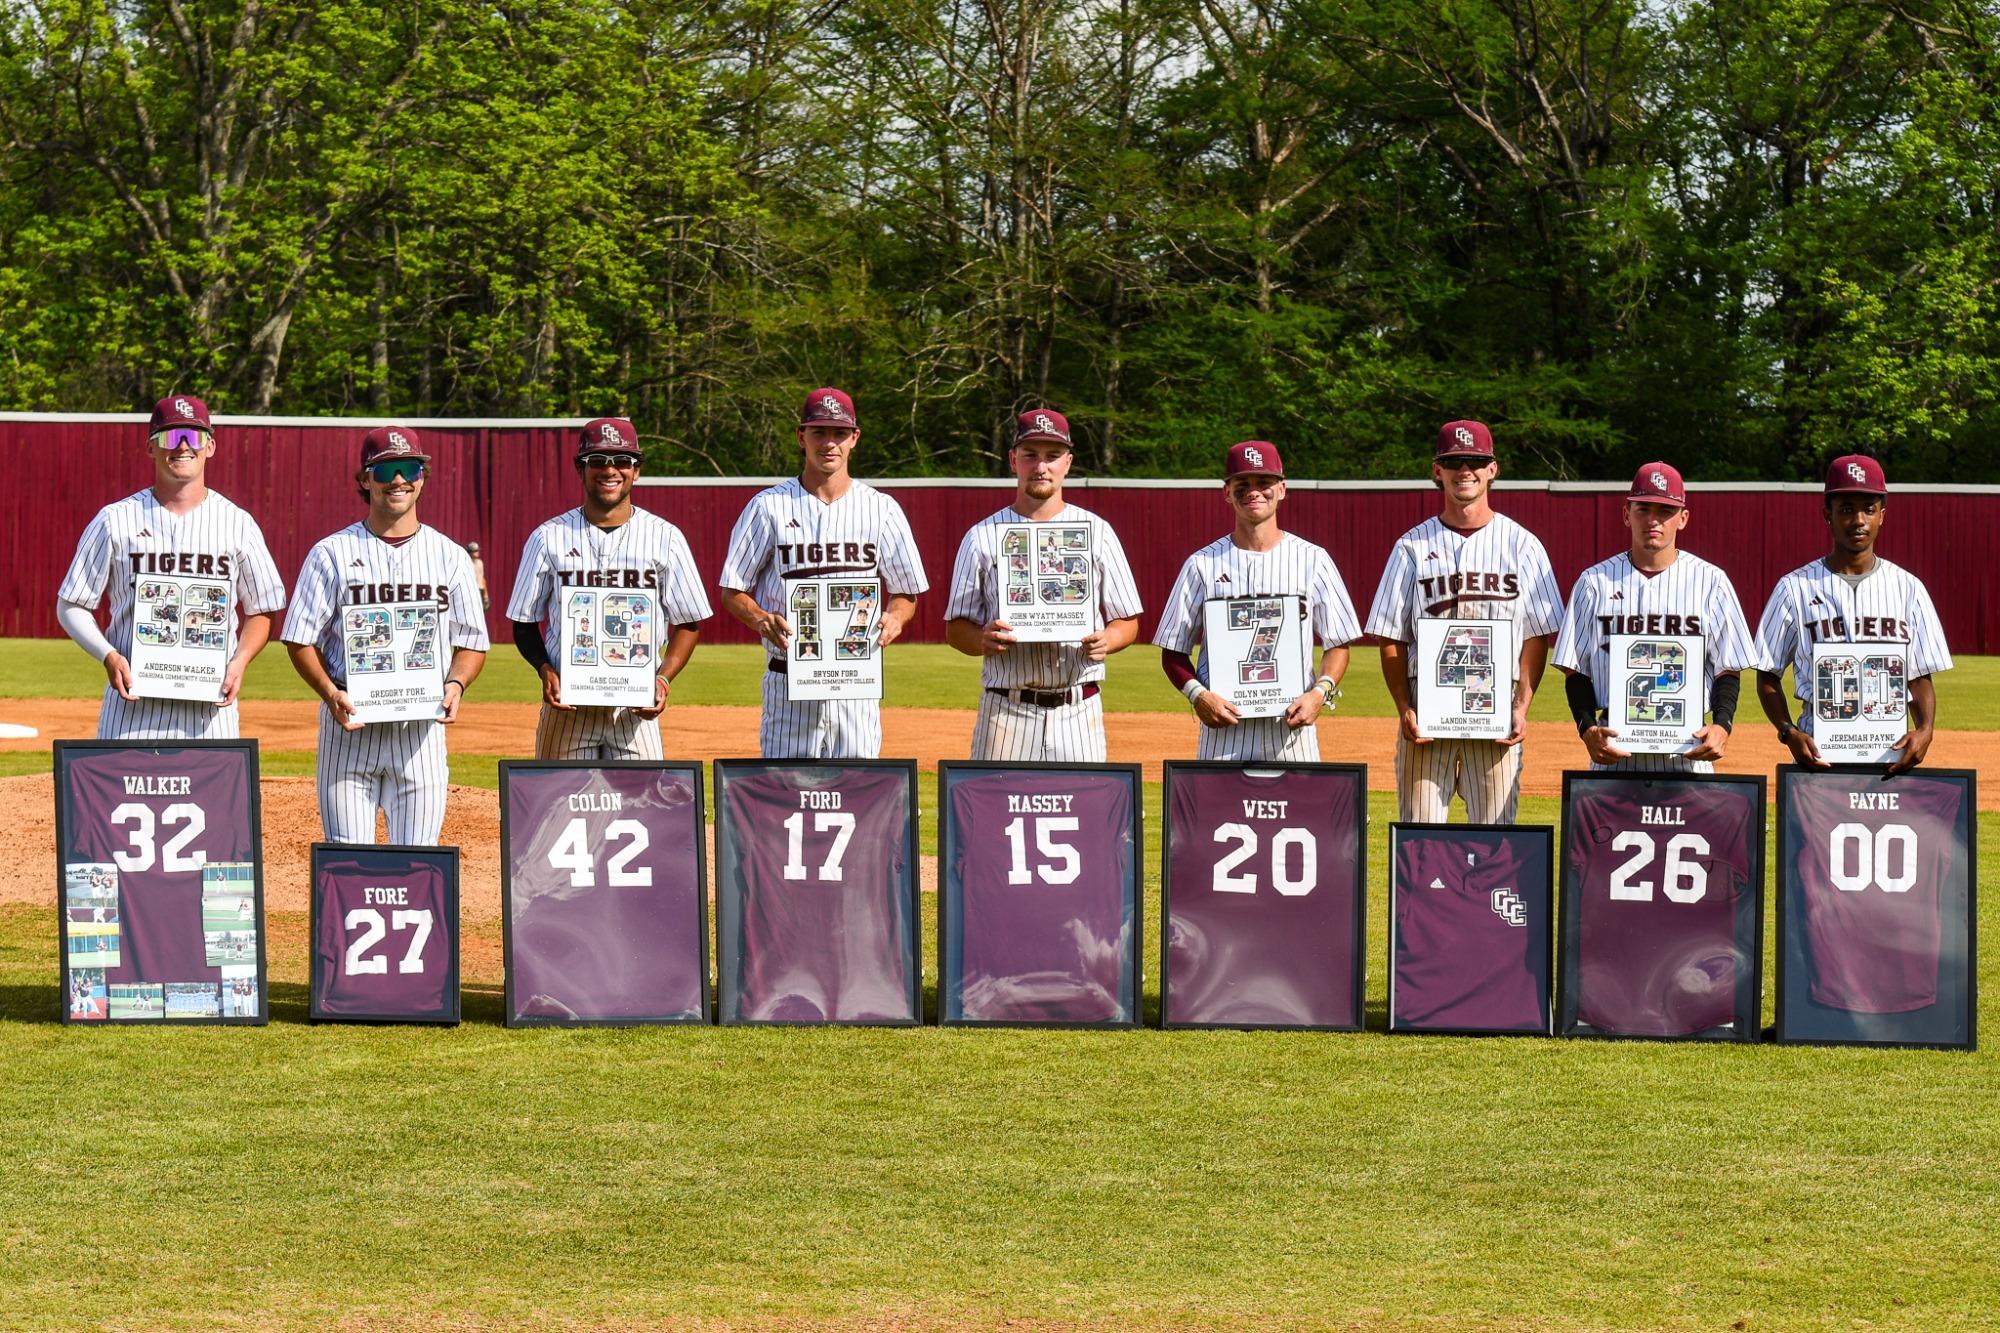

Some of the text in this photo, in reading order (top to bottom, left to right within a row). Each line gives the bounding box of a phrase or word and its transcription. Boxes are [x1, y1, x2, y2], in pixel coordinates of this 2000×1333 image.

[128, 552, 231, 577] TIGERS
[777, 542, 877, 564] TIGERS
[558, 569, 656, 588] TIGERS
[1001, 527, 1090, 605] 15
[349, 583, 450, 606] TIGERS
[1418, 572, 1519, 599] TIGERS
[135, 580, 228, 651] 32
[791, 583, 878, 661] 17
[1010, 612, 1085, 620] JOHN WYATT MASSEY
[1598, 614, 1701, 635] TIGERS
[345, 605, 439, 675] 27
[568, 592, 653, 668] 19
[1227, 598, 1284, 684] 7
[1804, 616, 1909, 641] TIGERS
[144, 662, 216, 675] ANDERSON WALKER
[589, 676, 608, 684] GABE
[813, 670, 840, 678] BRYSON
[1436, 626, 1495, 714] 4
[370, 687, 425, 698] GREGORY FORE
[1233, 688, 1282, 699] COLYN WEST
[1625, 640, 1687, 727] 2
[1815, 655, 1907, 722] 00
[1440, 717, 1491, 726] LANDON SMITH
[1829, 733, 1896, 742] JEREMIAH PAYNE
[123, 776, 191, 795] WALKER
[568, 789, 622, 812] COLÓN
[799, 790, 842, 810] FORD
[1008, 794, 1074, 813] MASSEY
[1242, 799, 1288, 819] WEST
[1849, 792, 1900, 810] PAYNE
[1640, 806, 1685, 825] HALL
[111, 803, 207, 873] 32
[783, 812, 856, 882] 17
[1004, 816, 1081, 885] 15
[547, 817, 653, 887] 42
[1212, 822, 1317, 896] 20
[1829, 822, 1918, 893] 00
[1610, 830, 1710, 904] 26
[364, 887, 409, 905] FORE
[1490, 887, 1528, 927] CCC
[344, 908, 434, 976] 27
